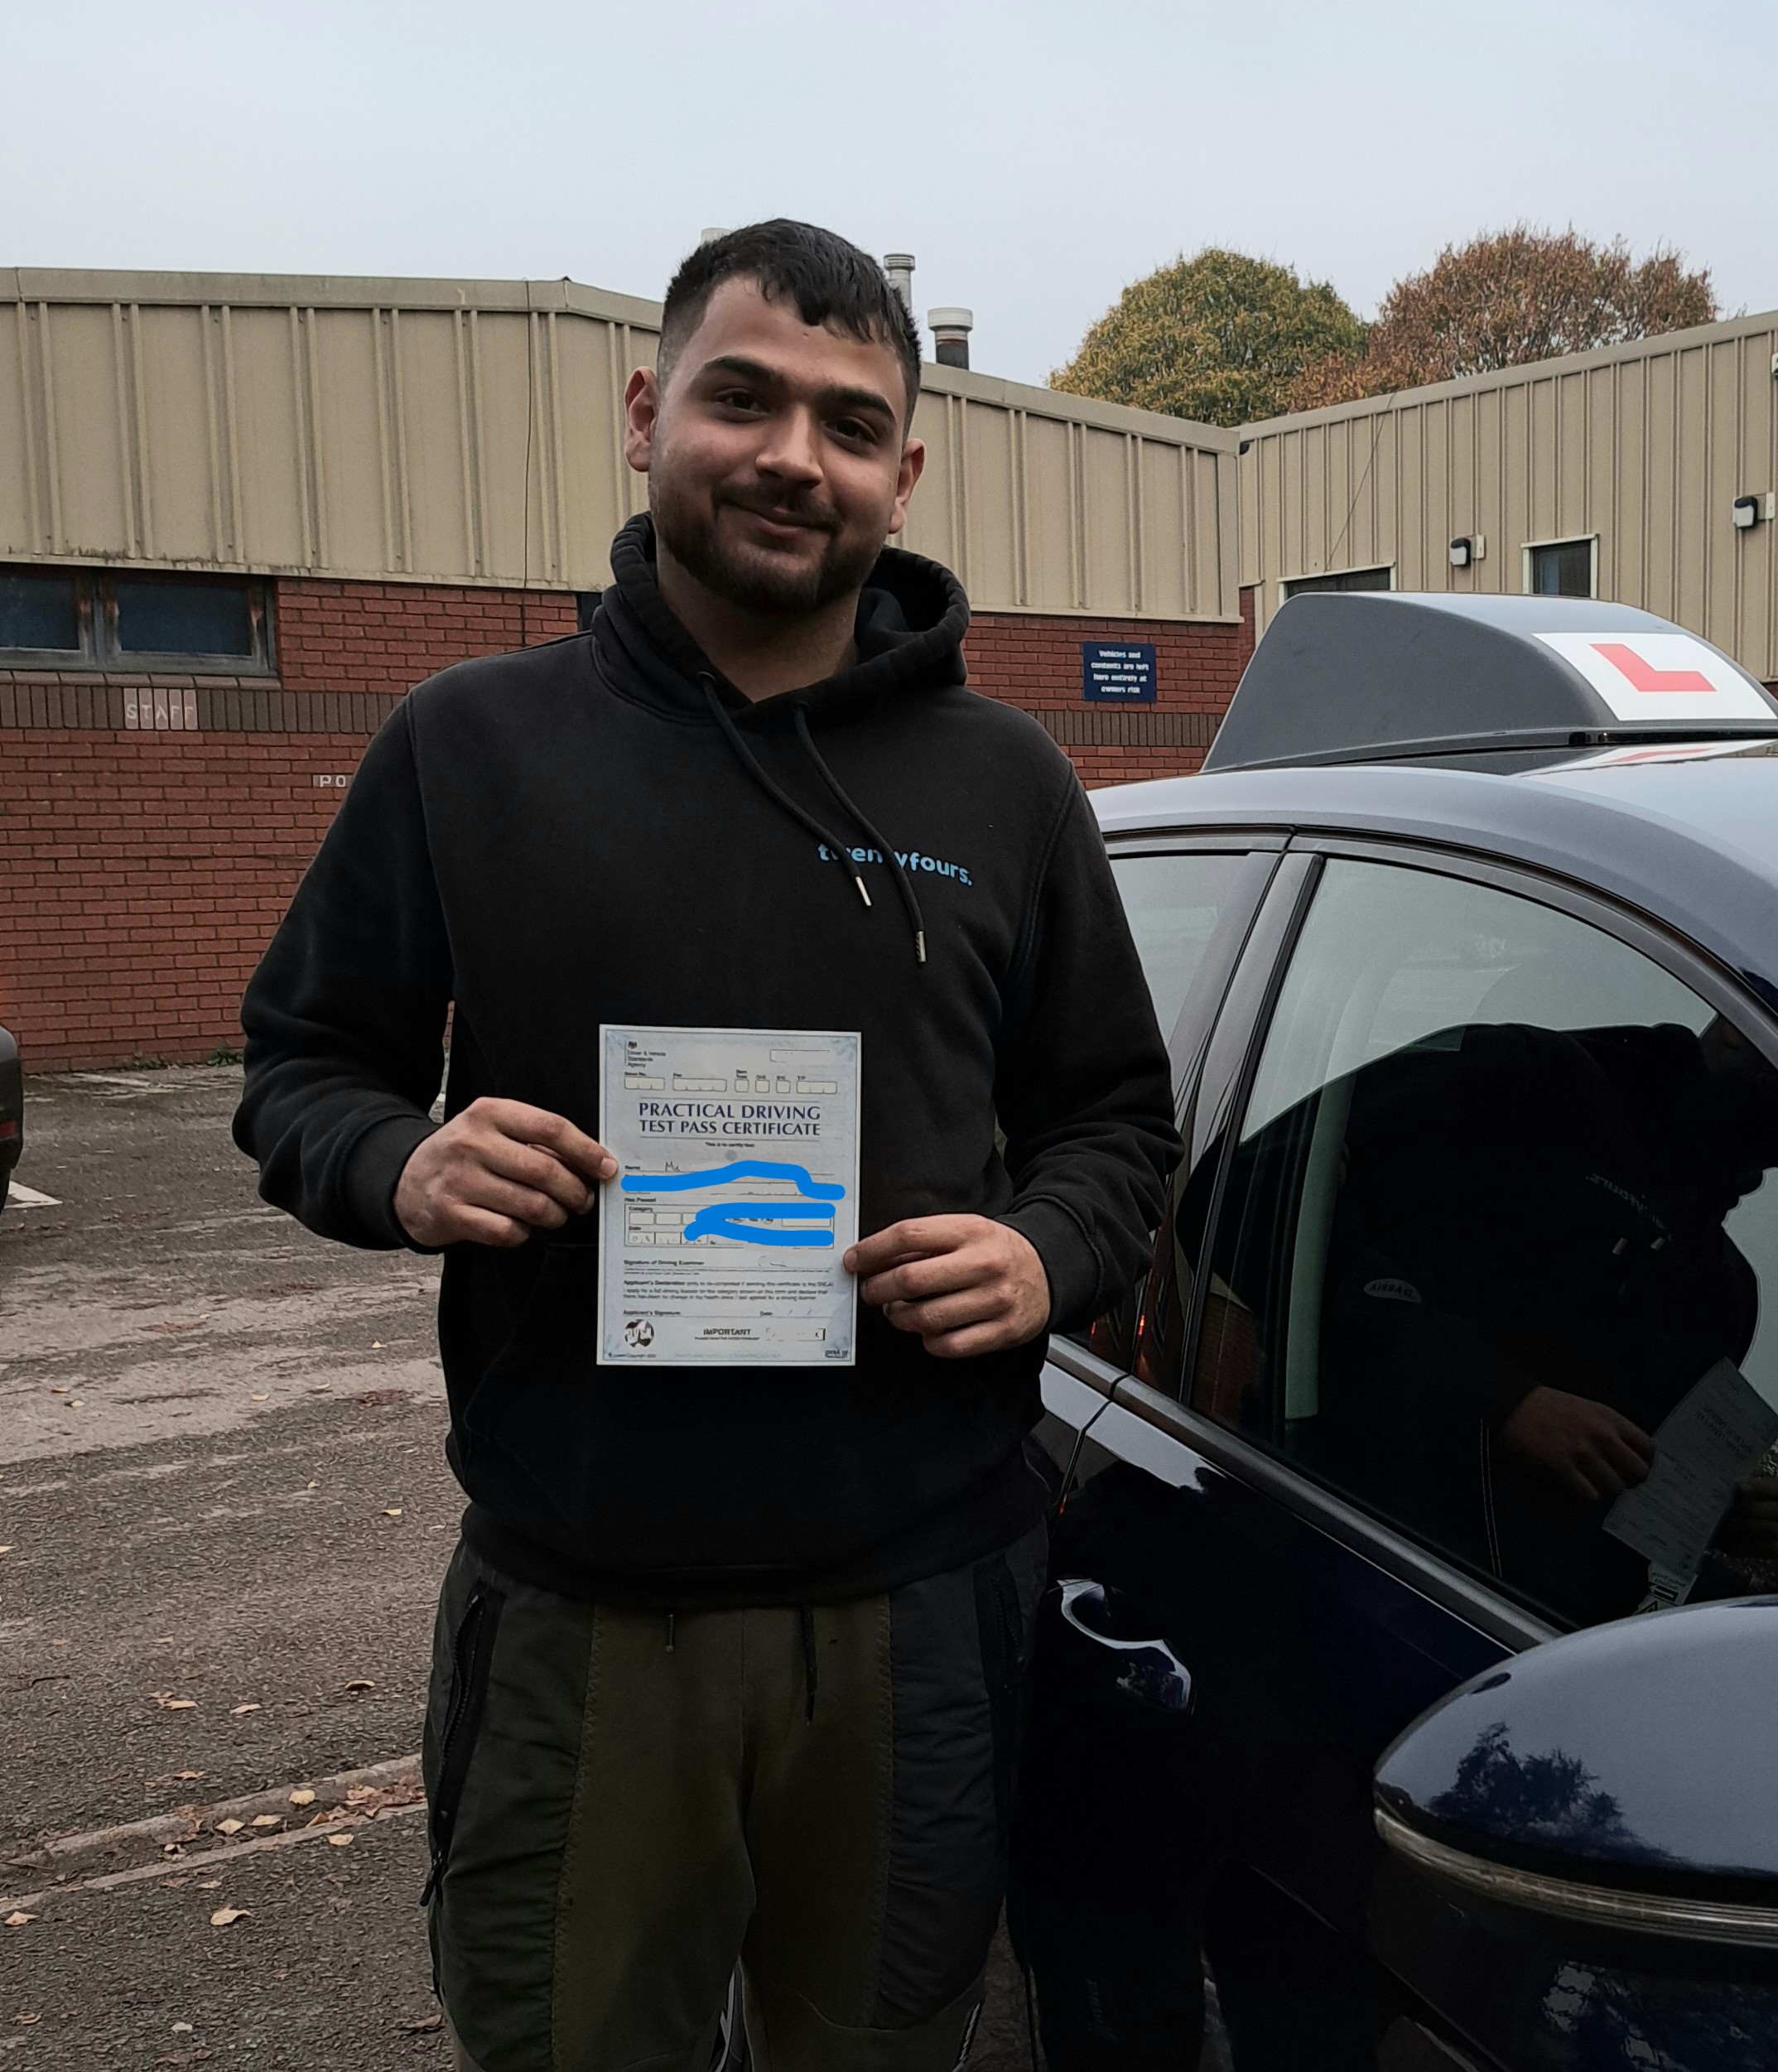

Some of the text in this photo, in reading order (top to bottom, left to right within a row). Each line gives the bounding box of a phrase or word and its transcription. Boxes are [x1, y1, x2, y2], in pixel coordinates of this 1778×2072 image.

[1098, 650, 1126, 658] Vehicles
[1588, 643, 1718, 692] L
[1111, 674, 1138, 683] entirely
[1127, 686, 1141, 694] risk
[126, 704, 194, 720] STAFF
[638, 1102, 821, 1120] PRACTICAL DRIVING
[639, 1120, 821, 1136] TEST PASS CERTIFICATE
[1369, 1284, 1413, 1298] AIRBAG
